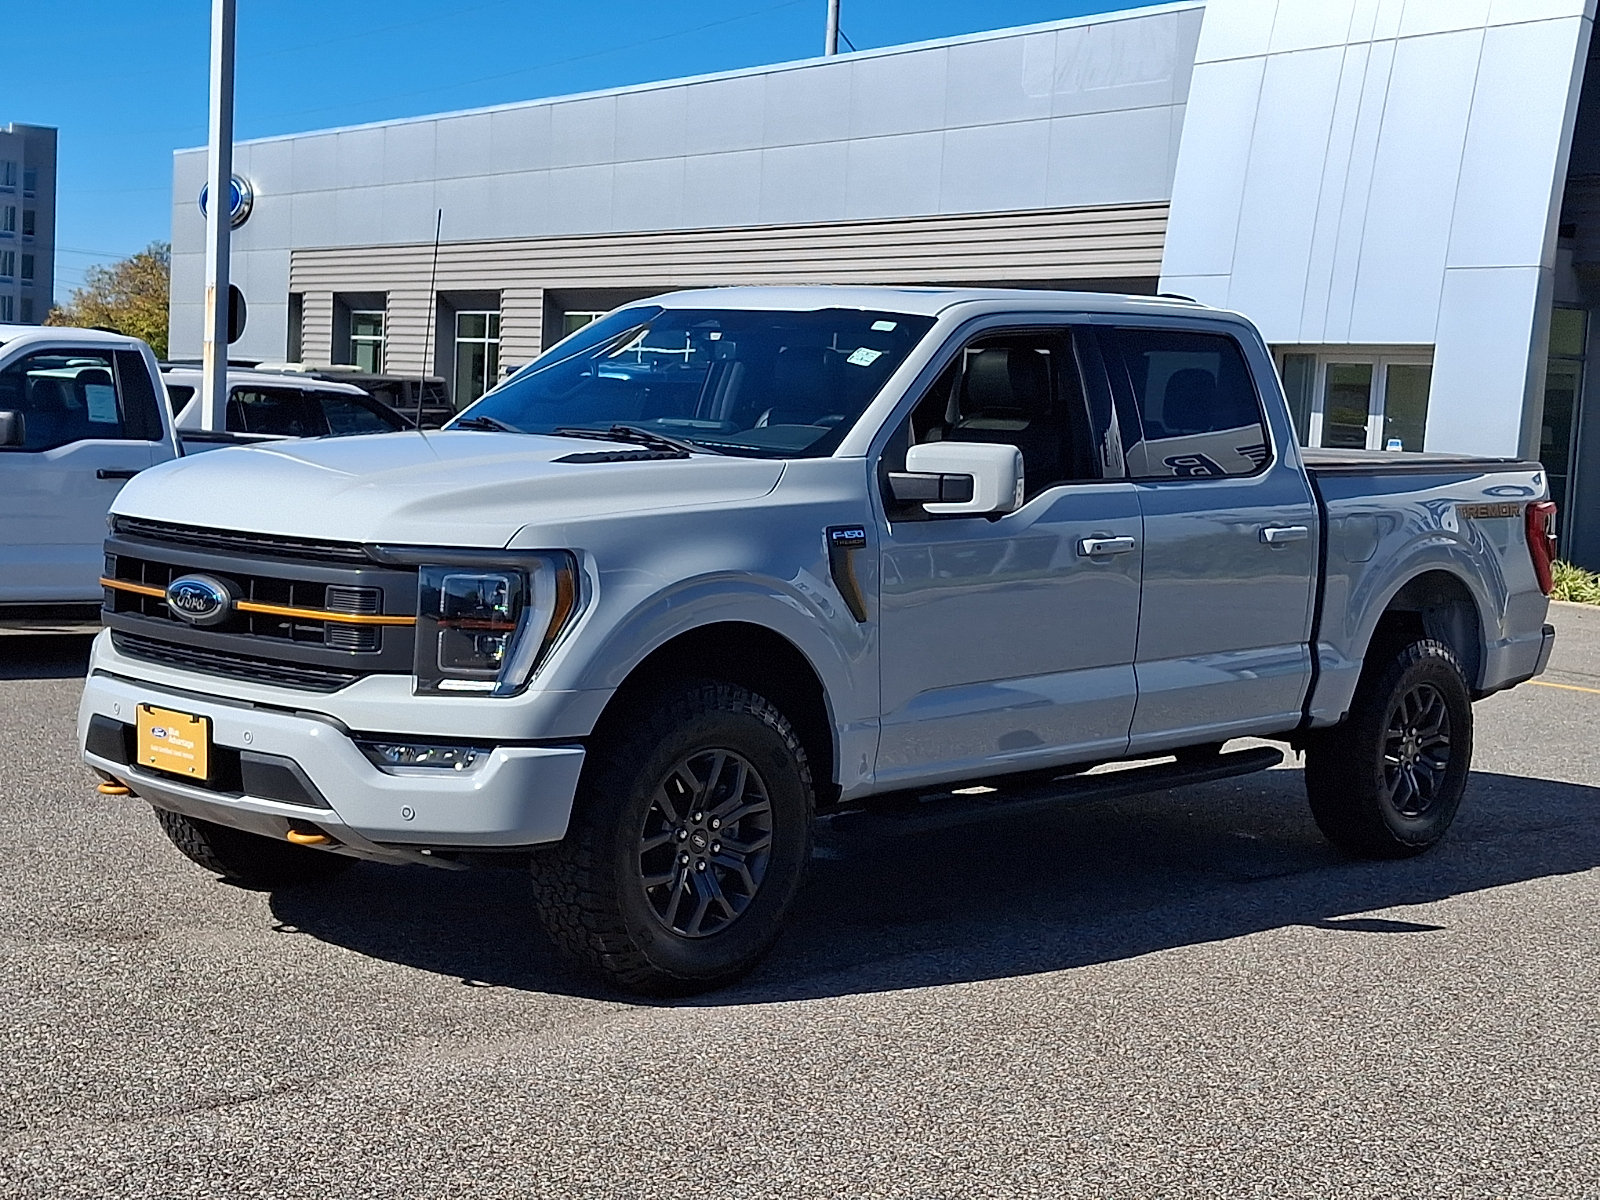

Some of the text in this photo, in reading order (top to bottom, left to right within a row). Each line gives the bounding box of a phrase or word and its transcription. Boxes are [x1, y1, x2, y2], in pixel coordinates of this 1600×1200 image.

[1456, 503, 1520, 517] TREMOR
[833, 530, 865, 539] F-150
[177, 586, 208, 611] Ford
